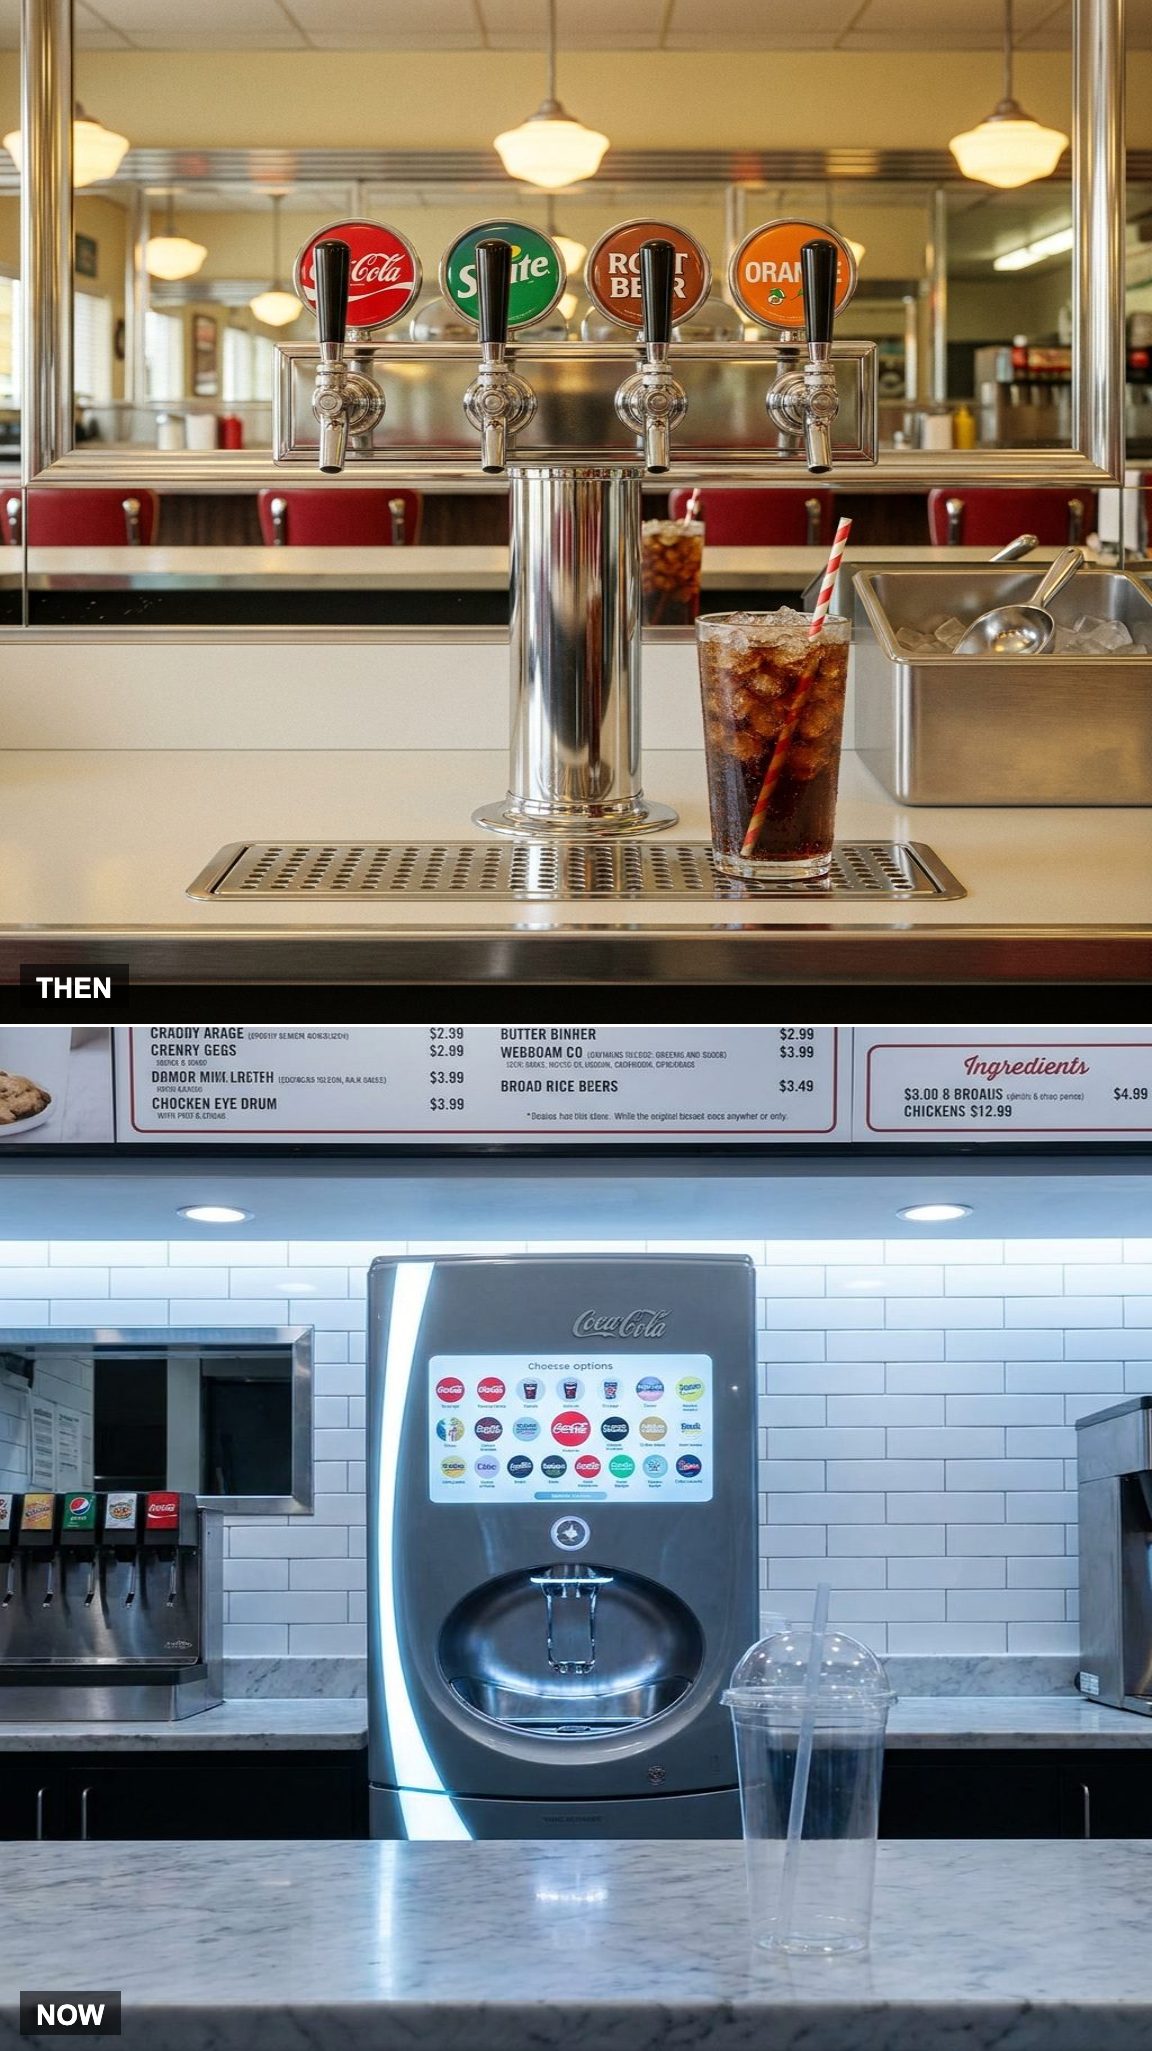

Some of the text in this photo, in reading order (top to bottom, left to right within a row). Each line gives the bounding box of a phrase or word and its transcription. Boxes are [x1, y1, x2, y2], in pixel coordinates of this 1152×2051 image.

[608, 253, 688, 274] ROT
[457, 253, 550, 299] Site
[745, 261, 842, 283] ORAN
[610, 277, 686, 299] BER
[203, 1027, 244, 1040] ARAGE
[501, 1028, 596, 1040] BUTTER BINHER
[779, 1028, 814, 1042] $2.99
[151, 1044, 199, 1056] CRENRY
[429, 1044, 464, 1058] $2.99
[500, 1046, 562, 1058] WEBBOAM
[566, 1046, 582, 1058] CO
[779, 1045, 814, 1059] $3.99
[963, 1055, 1090, 1081] Ingredients
[430, 1071, 464, 1085] $3.99
[501, 1080, 542, 1092] BROAD
[546, 1080, 575, 1092] RICE
[779, 1079, 814, 1093] $3.49
[904, 1088, 938, 1102] $3.00
[1114, 1087, 1149, 1101] $4.99
[152, 1097, 278, 1110] CHOCKEN EYE DRUM
[430, 1097, 464, 1111] $3.99
[904, 1105, 1012, 1119] CHICKENS $12.99
[573, 1362, 614, 1373] options
